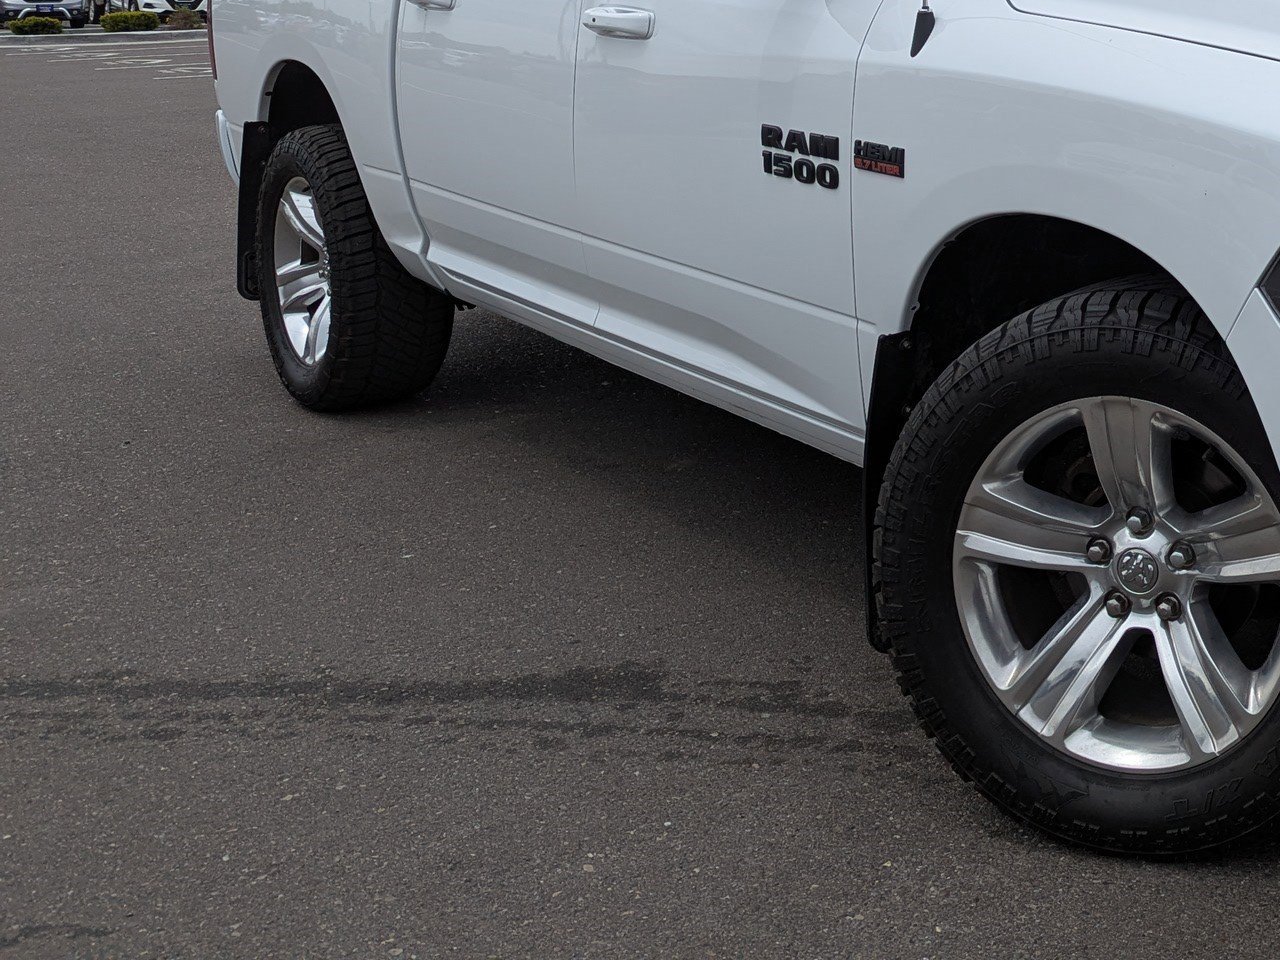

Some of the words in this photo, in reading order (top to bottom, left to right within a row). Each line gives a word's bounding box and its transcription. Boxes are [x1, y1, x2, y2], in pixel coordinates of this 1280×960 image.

[761, 123, 839, 161] RAM
[854, 139, 906, 164] HEMI
[762, 150, 840, 190] 1500
[871, 160, 901, 176] LITER
